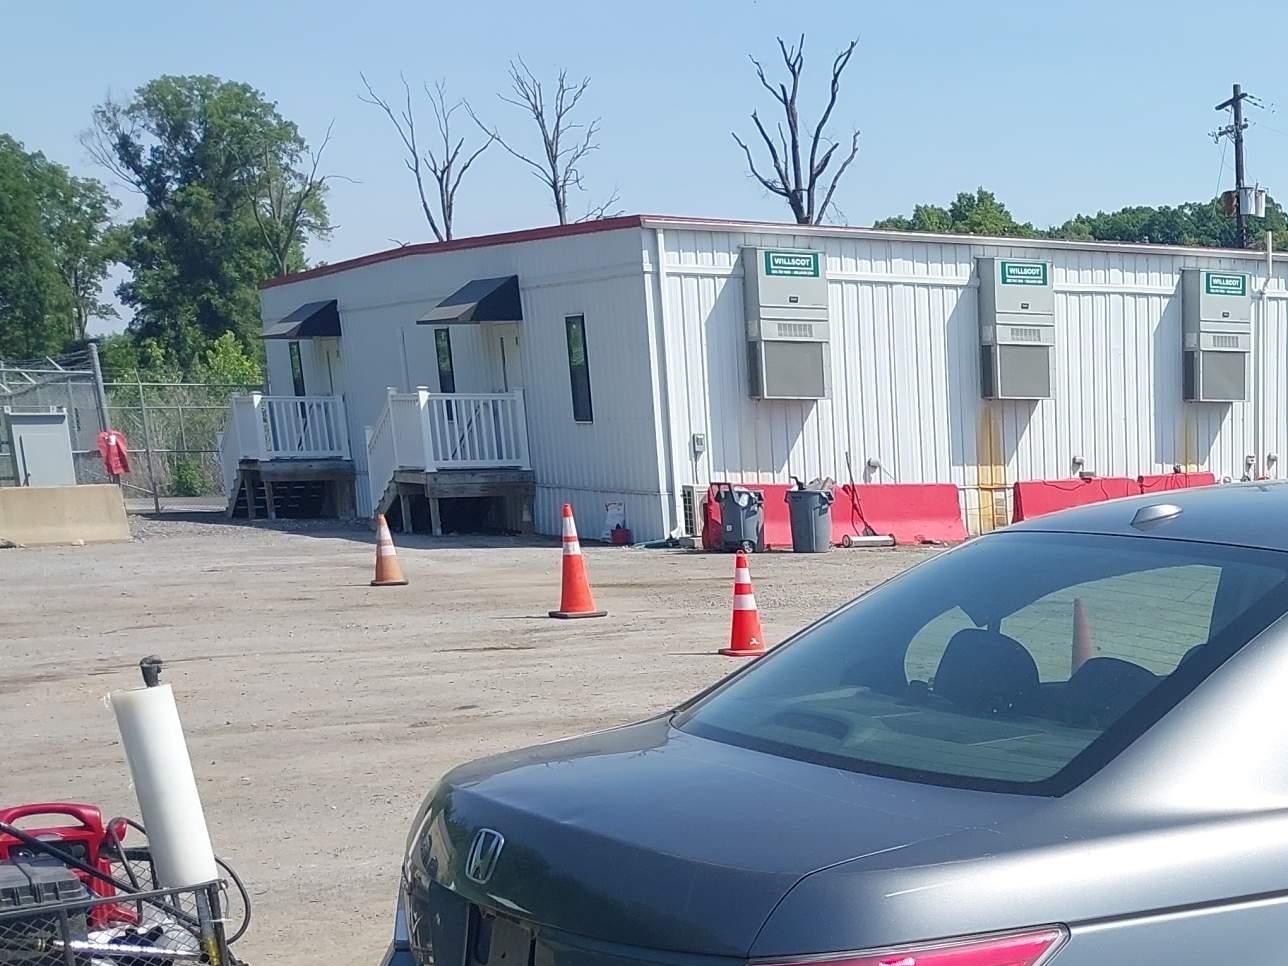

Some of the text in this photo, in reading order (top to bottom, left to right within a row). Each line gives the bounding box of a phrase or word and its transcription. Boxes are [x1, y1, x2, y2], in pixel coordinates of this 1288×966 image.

[774, 257, 811, 266] WILLSCOT
[1009, 267, 1041, 276] WILLSCOT
[1212, 278, 1240, 287] WILLSCOT
